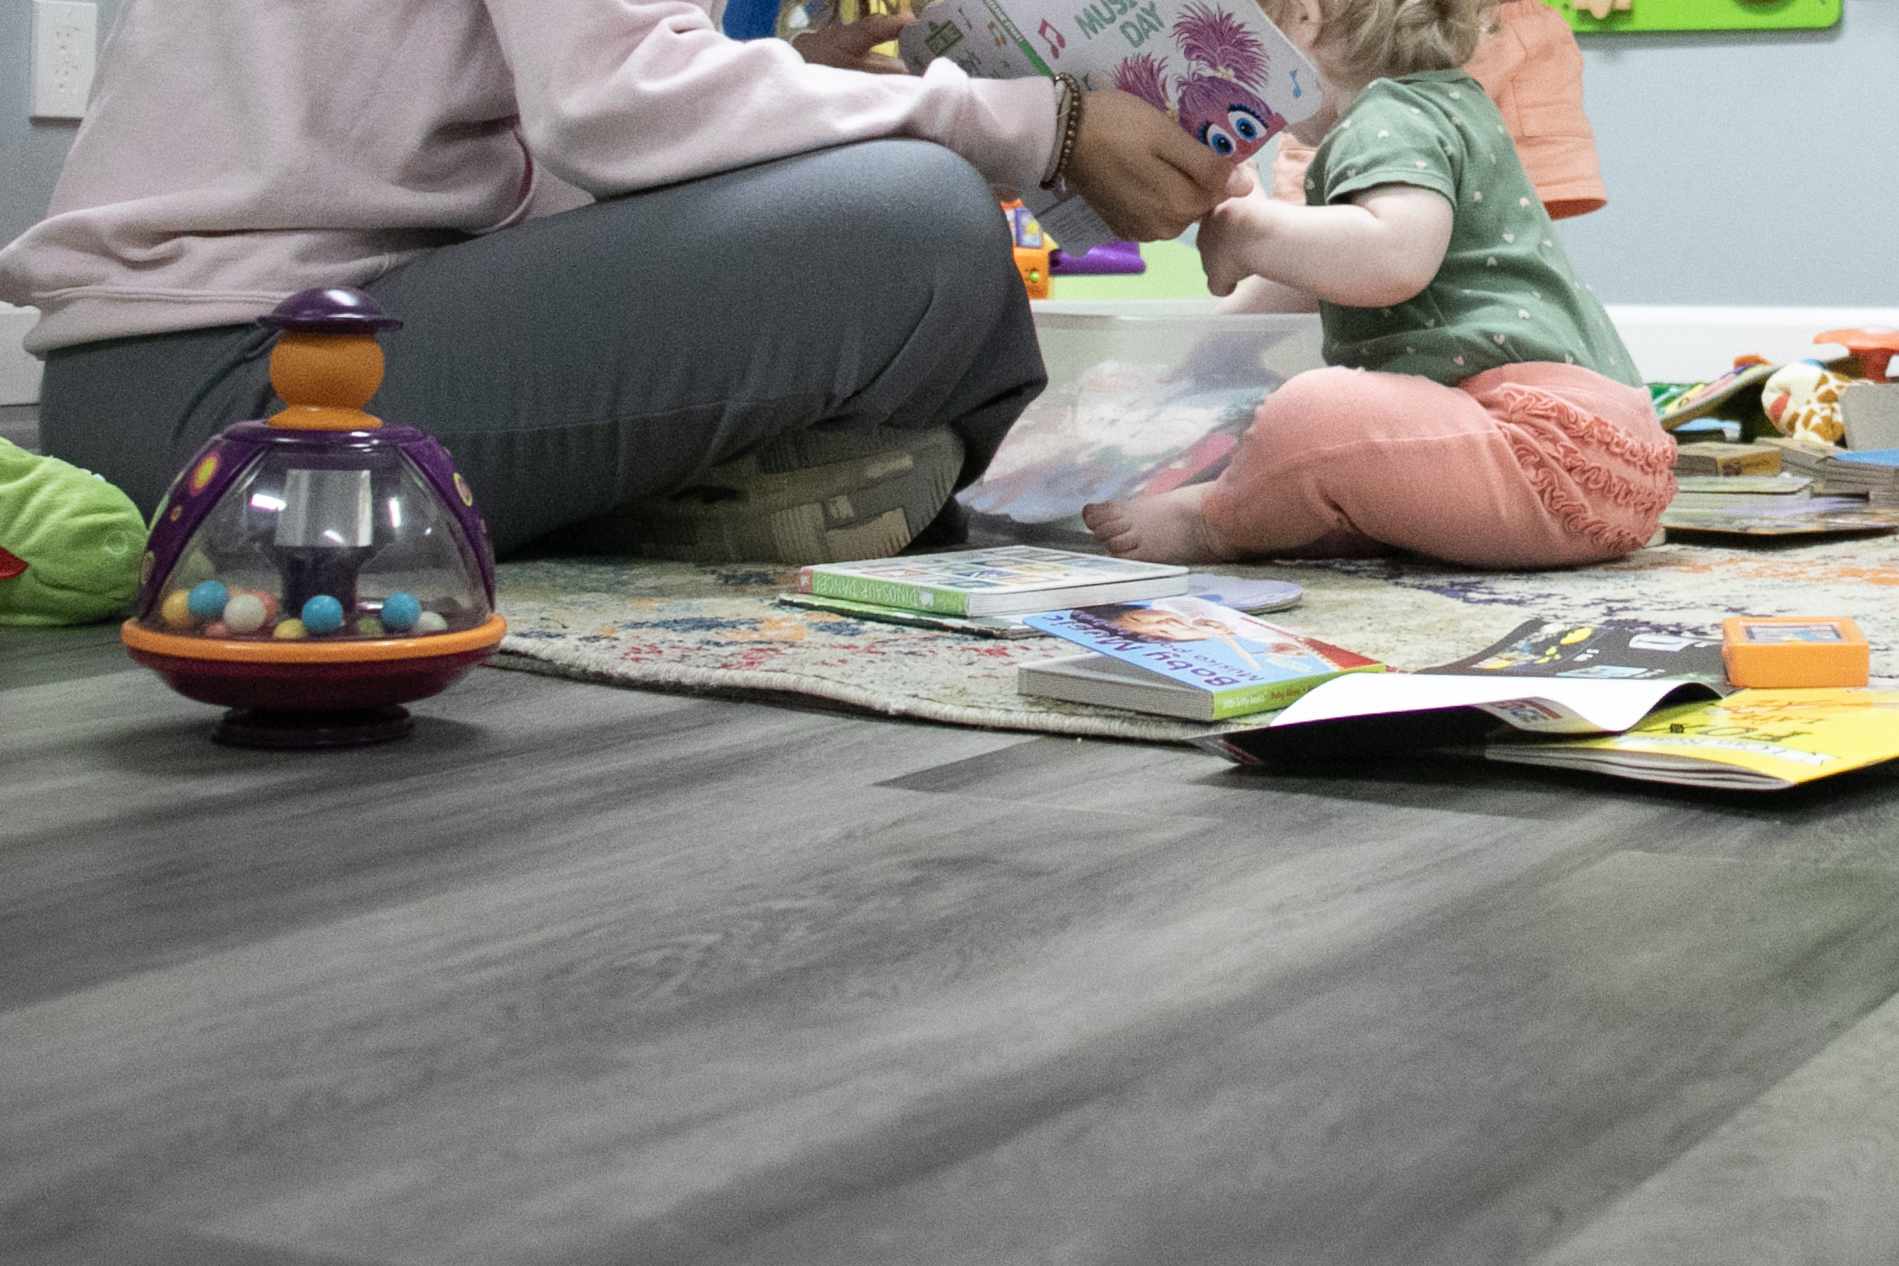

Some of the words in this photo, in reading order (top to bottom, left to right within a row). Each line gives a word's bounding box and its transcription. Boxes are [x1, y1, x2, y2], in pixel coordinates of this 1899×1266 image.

[1119, 0, 1165, 48] DAY
[860, 582, 918, 607] DINOSAUR
[1041, 614, 1142, 653] Music
[1142, 649, 1241, 687] Baby
